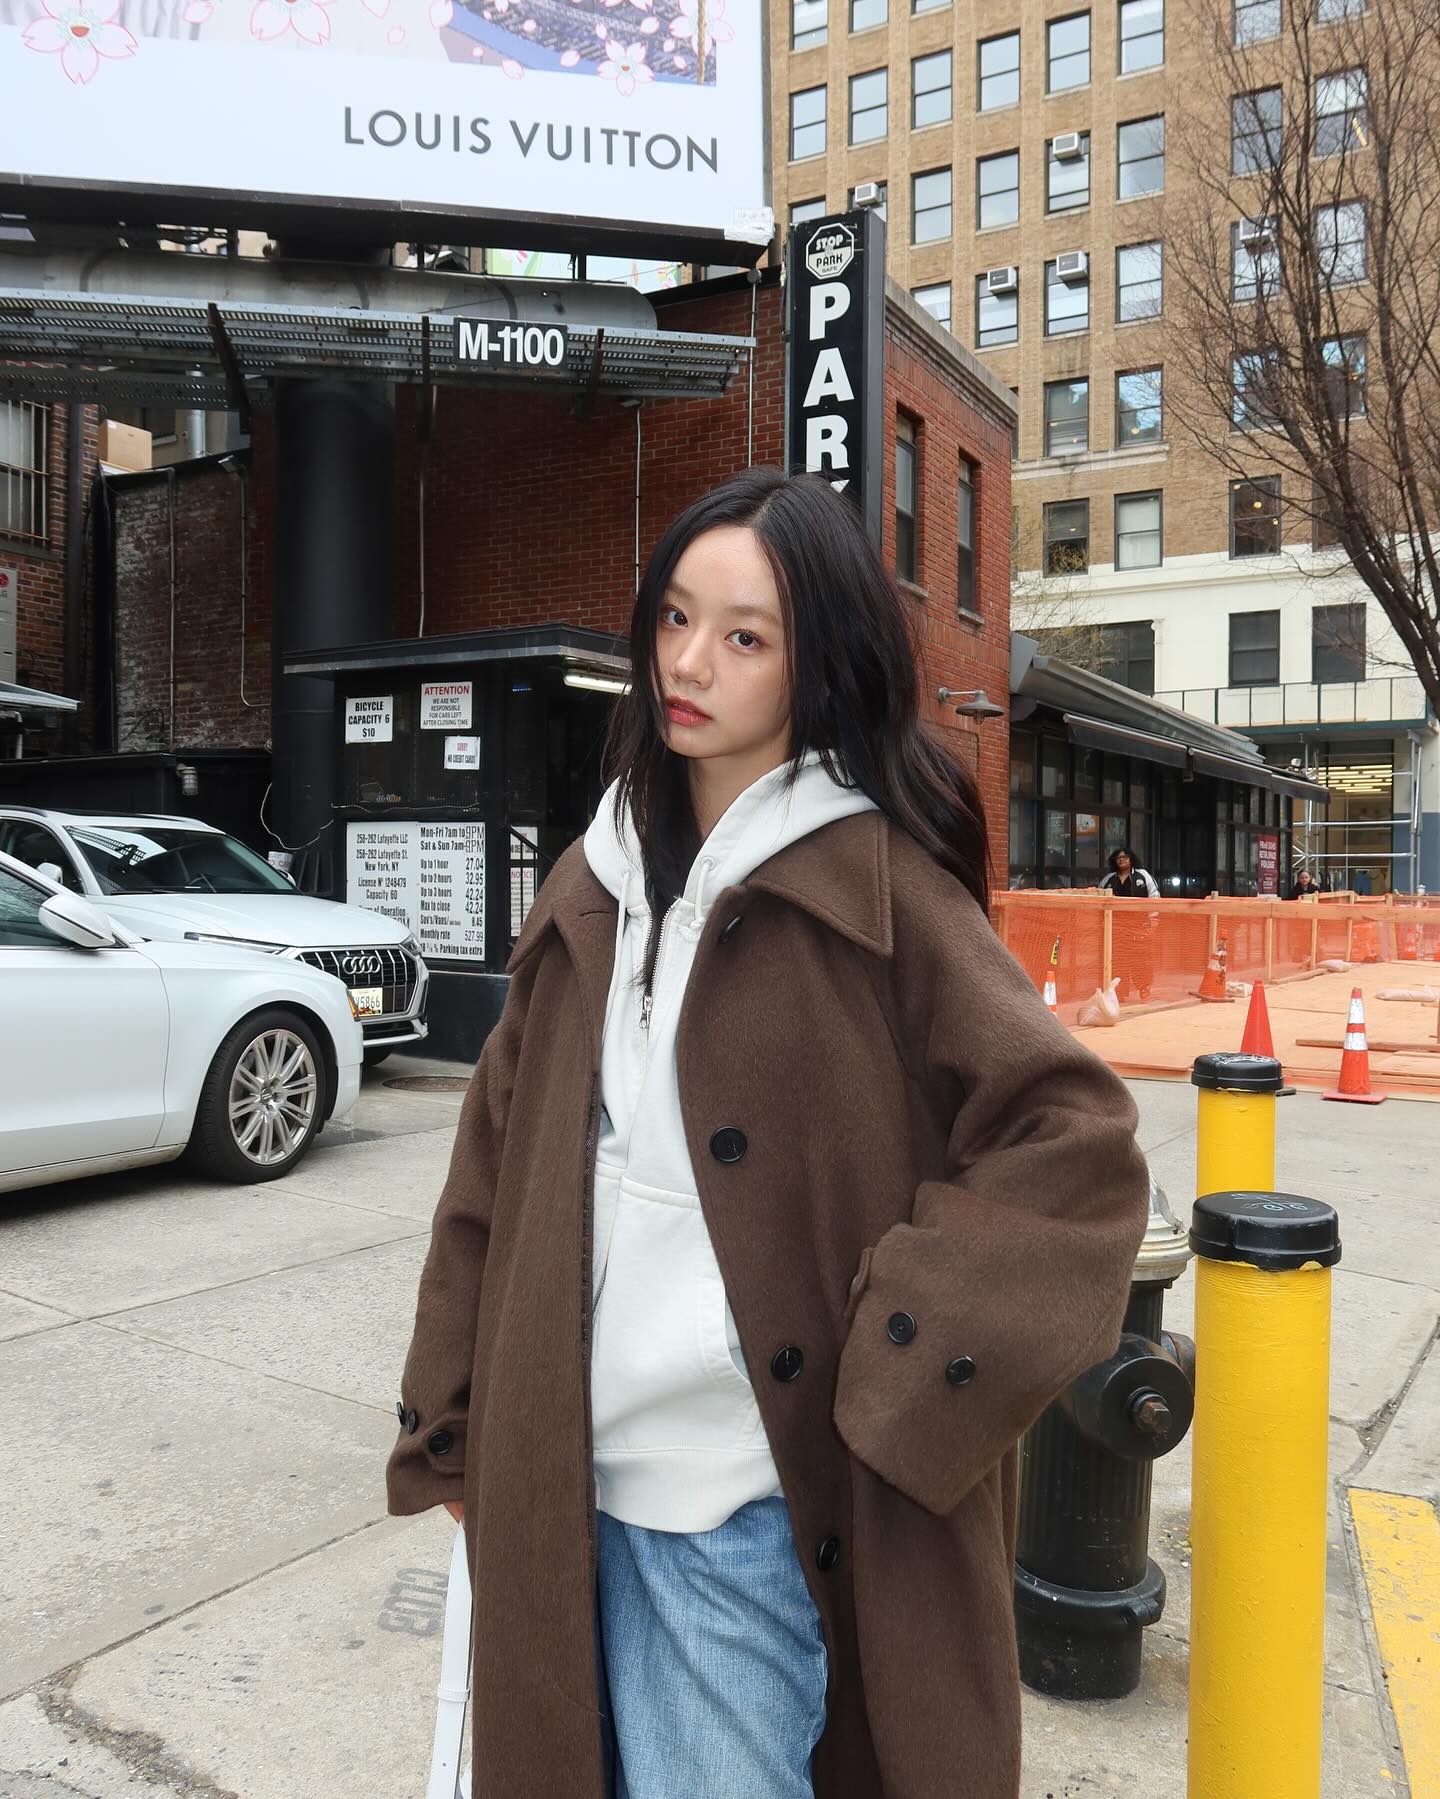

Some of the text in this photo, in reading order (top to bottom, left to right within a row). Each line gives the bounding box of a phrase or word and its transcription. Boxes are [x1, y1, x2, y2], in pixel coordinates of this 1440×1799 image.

[344, 106, 719, 174] LOUIS VUITTON
[816, 234, 844, 251] STOP
[816, 253, 842, 268] PARK
[459, 321, 564, 366] M-1100
[802, 282, 855, 494] PAR
[424, 686, 470, 696] ATTENTION
[355, 701, 383, 711] BICYCLE
[348, 714, 390, 725] CAPACITY 6
[421, 826, 484, 839] Mon-Fri 7am to 9PM
[356, 834, 408, 845] 258-262 Lafayette LLC
[421, 840, 430, 850] Sat
[432, 842, 436, 850] &
[438, 840, 449, 850] Sun
[356, 849, 377, 859] 258-262
[378, 849, 400, 860] Lafayette
[365, 862, 376, 871] New
[392, 862, 399, 871] NY
[421, 858, 427, 869] Up
[428, 860, 433, 869] to
[437, 859, 448, 869] hour
[466, 857, 484, 870] 27.04
[358, 877, 376, 887] License
[421, 873, 427, 883] Up
[428, 873, 433, 883] to
[438, 873, 452, 883] hours
[465, 872, 484, 885] 32.95
[366, 889, 398, 901] Capacity 60
[421, 887, 427, 897] Up
[428, 888, 433, 897] to
[438, 887, 452, 897] hours
[466, 888, 484, 900] 42.24
[421, 900, 483, 914] Max to close 42.24
[472, 916, 483, 927] 8.45
[420, 928, 483, 942] Monthly rate 527.99
[440, 944, 459, 955] Parking
[460, 946, 468, 955] tax
[469, 946, 482, 955] extra
